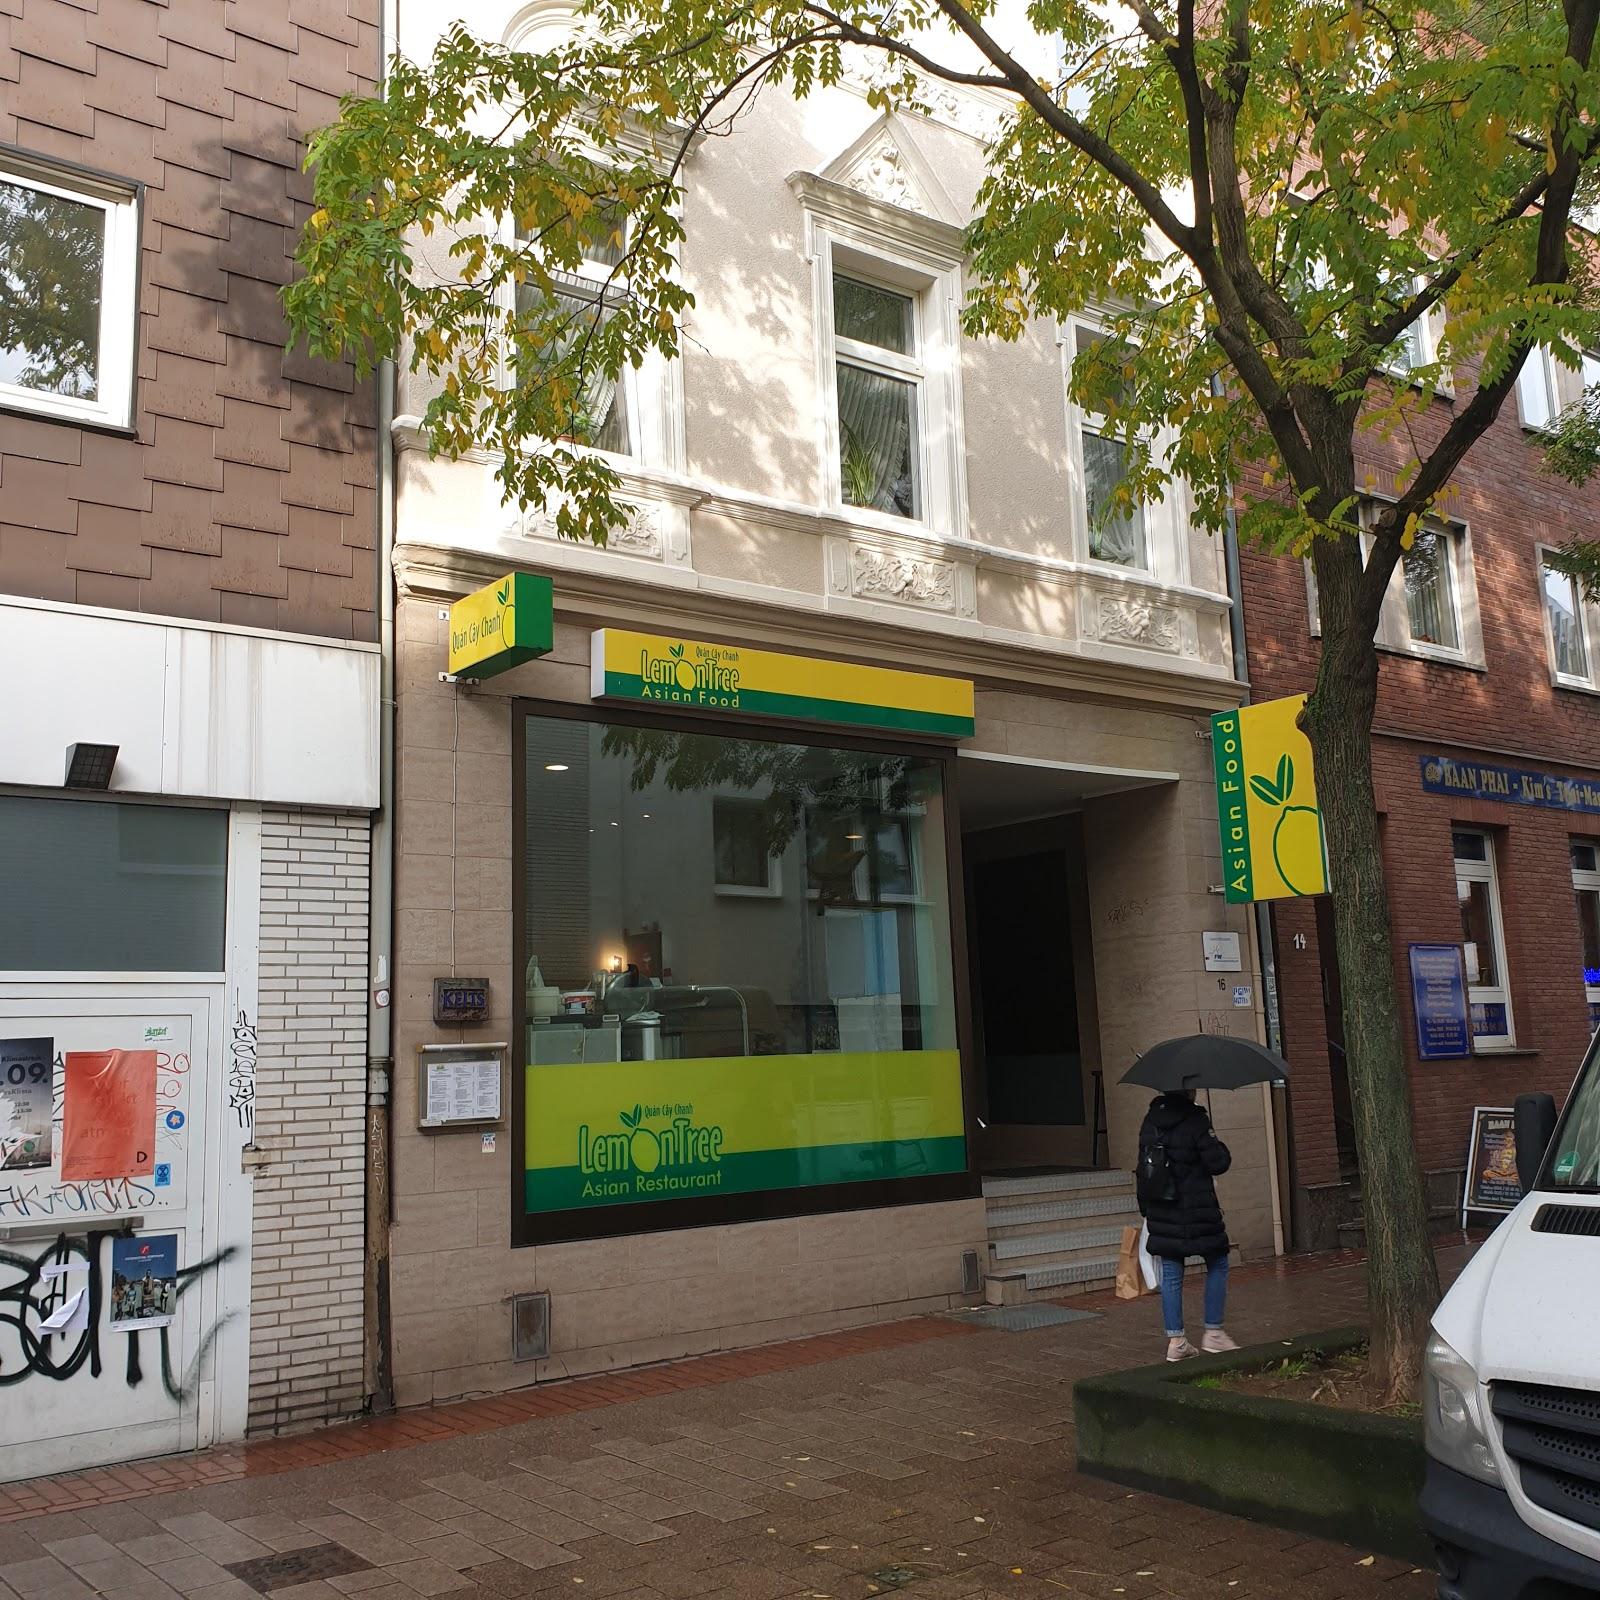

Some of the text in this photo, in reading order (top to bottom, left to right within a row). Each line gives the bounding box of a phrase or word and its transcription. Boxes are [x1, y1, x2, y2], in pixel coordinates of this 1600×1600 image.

[481, 609, 501, 638] Chanh
[722, 649, 740, 661] Chanh
[641, 684, 740, 708] Asian Food
[1480, 768, 1510, 795] PHAI
[1216, 718, 1248, 893] Asian Food
[1293, 933, 1307, 950] 14
[1217, 978, 1227, 991] 16
[674, 1102, 693, 1116] Chanh
[582, 1170, 722, 1198] Asian Restaurant
